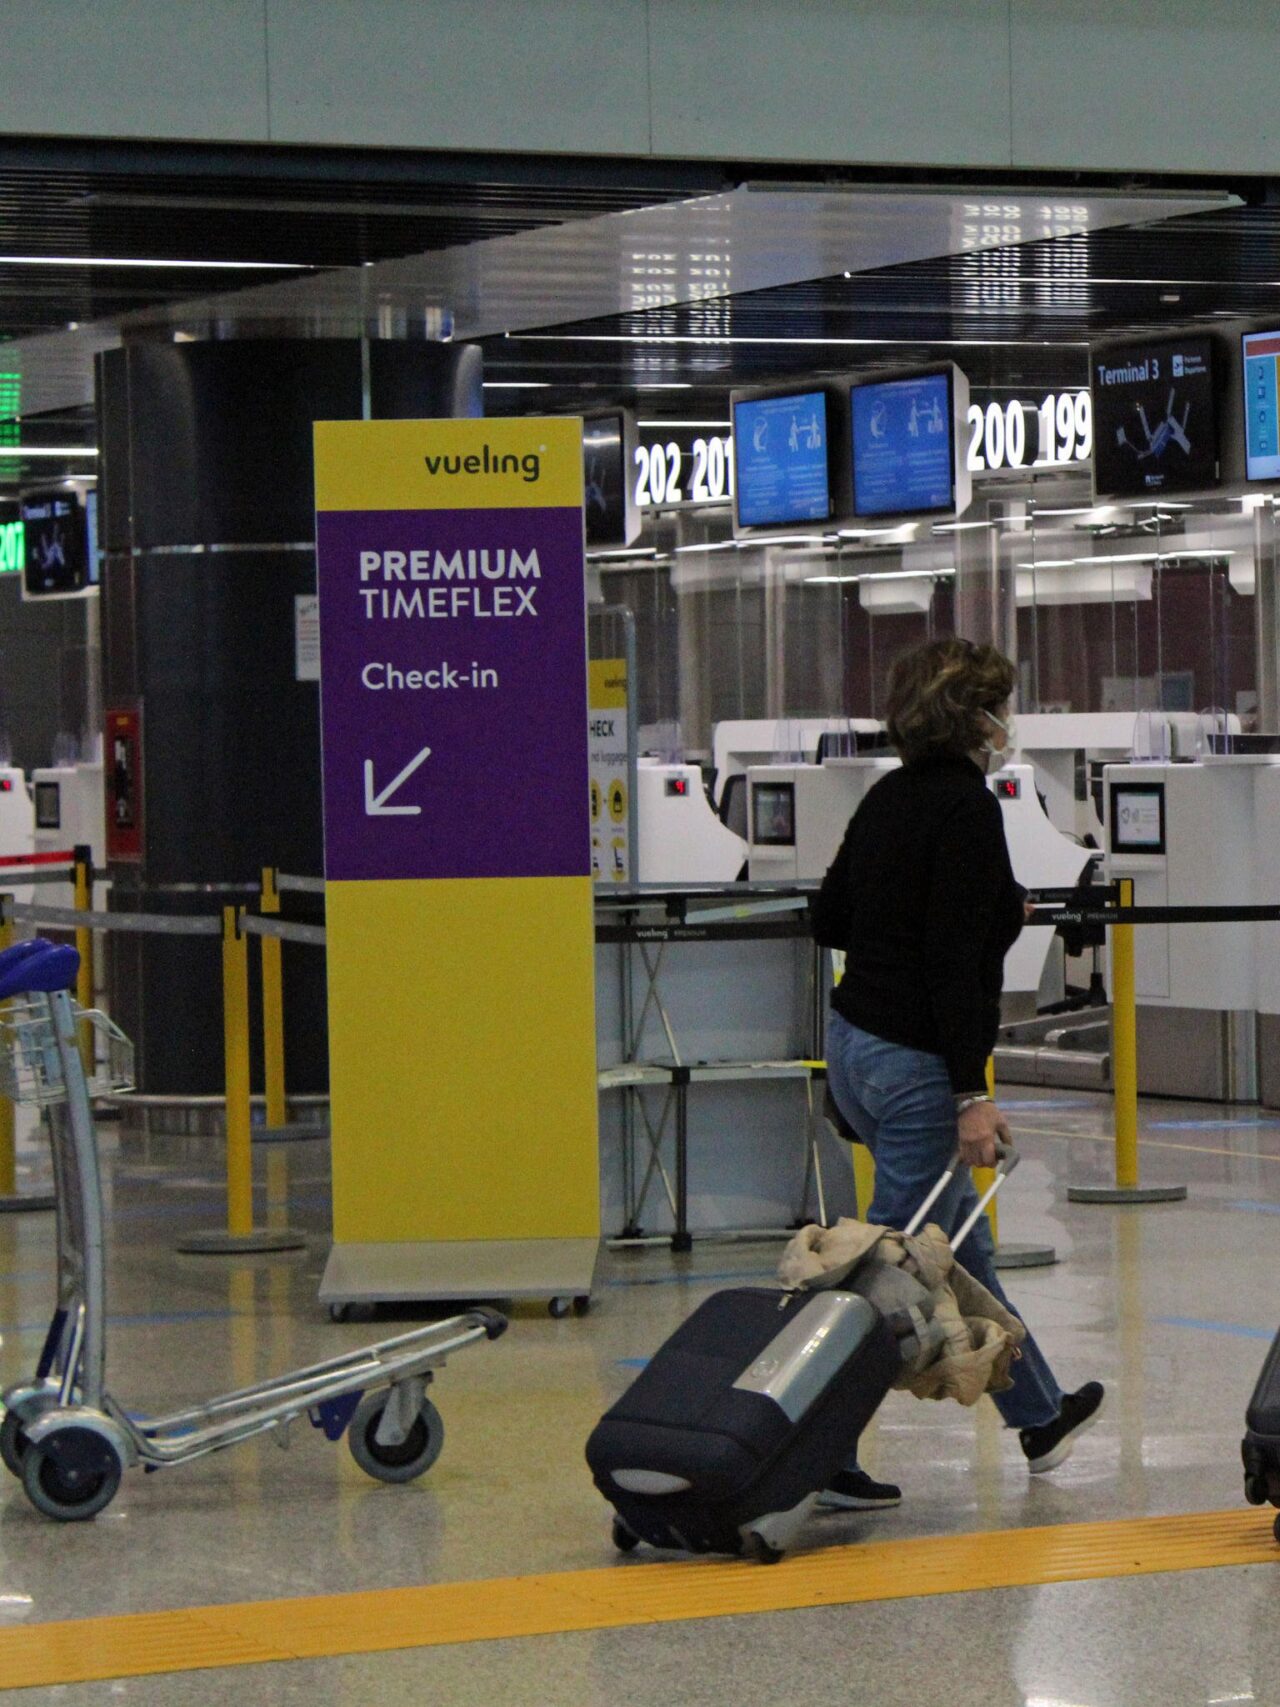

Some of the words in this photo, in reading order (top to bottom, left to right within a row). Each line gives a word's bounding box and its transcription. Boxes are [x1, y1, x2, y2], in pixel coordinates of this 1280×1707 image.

[1098, 361, 1149, 386] Terminal
[1152, 358, 1160, 380] 3
[967, 399, 1025, 471] 200
[1041, 391, 1092, 463] 199
[424, 444, 540, 482] vueling
[635, 442, 682, 506] 202
[692, 436, 734, 503] 201
[360, 549, 543, 583] PREMIUM
[360, 587, 539, 620] TIMEFLEX
[361, 662, 499, 691] Check-in
[1052, 911, 1082, 922] vueling
[636, 928, 668, 940] vueling
